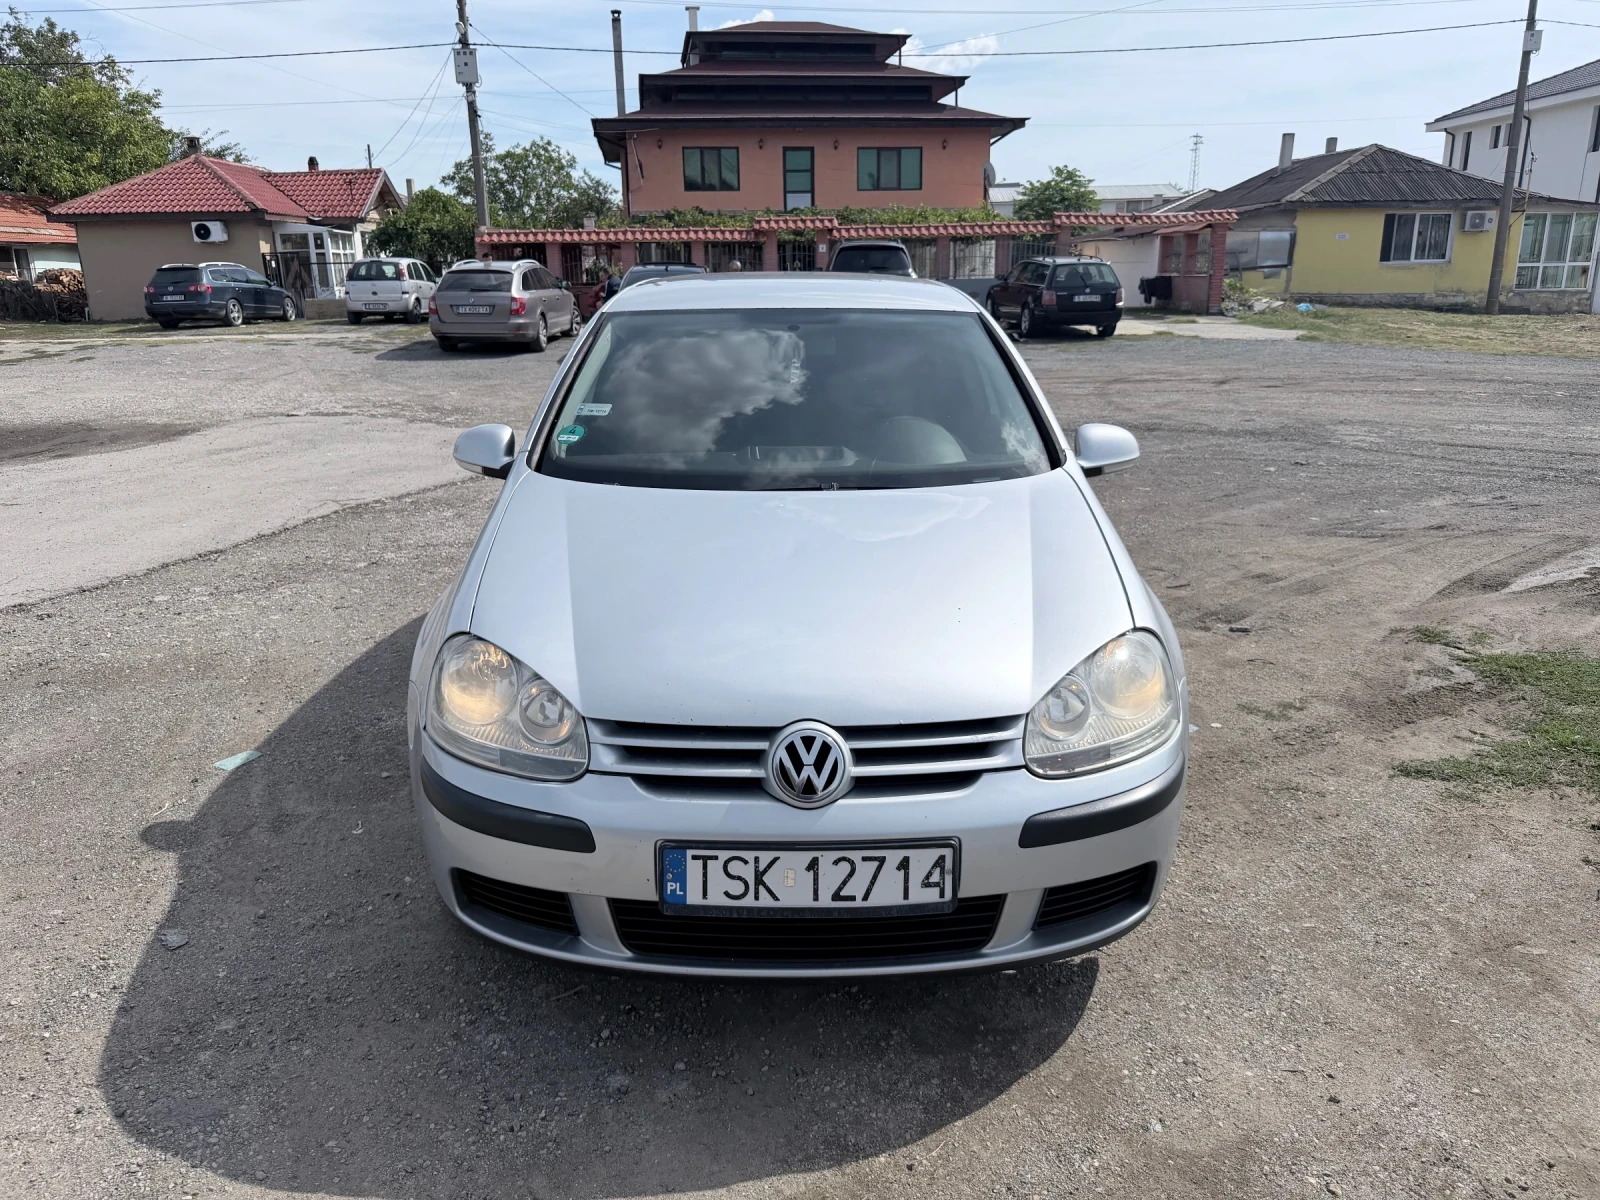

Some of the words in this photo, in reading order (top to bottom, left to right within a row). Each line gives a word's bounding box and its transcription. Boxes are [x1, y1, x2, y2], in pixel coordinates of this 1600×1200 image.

[791, 358, 800, 384] VIP
[568, 426, 577, 435] 4
[691, 854, 781, 901] TSK
[804, 854, 947, 901] 12714
[667, 881, 684, 895] PL
